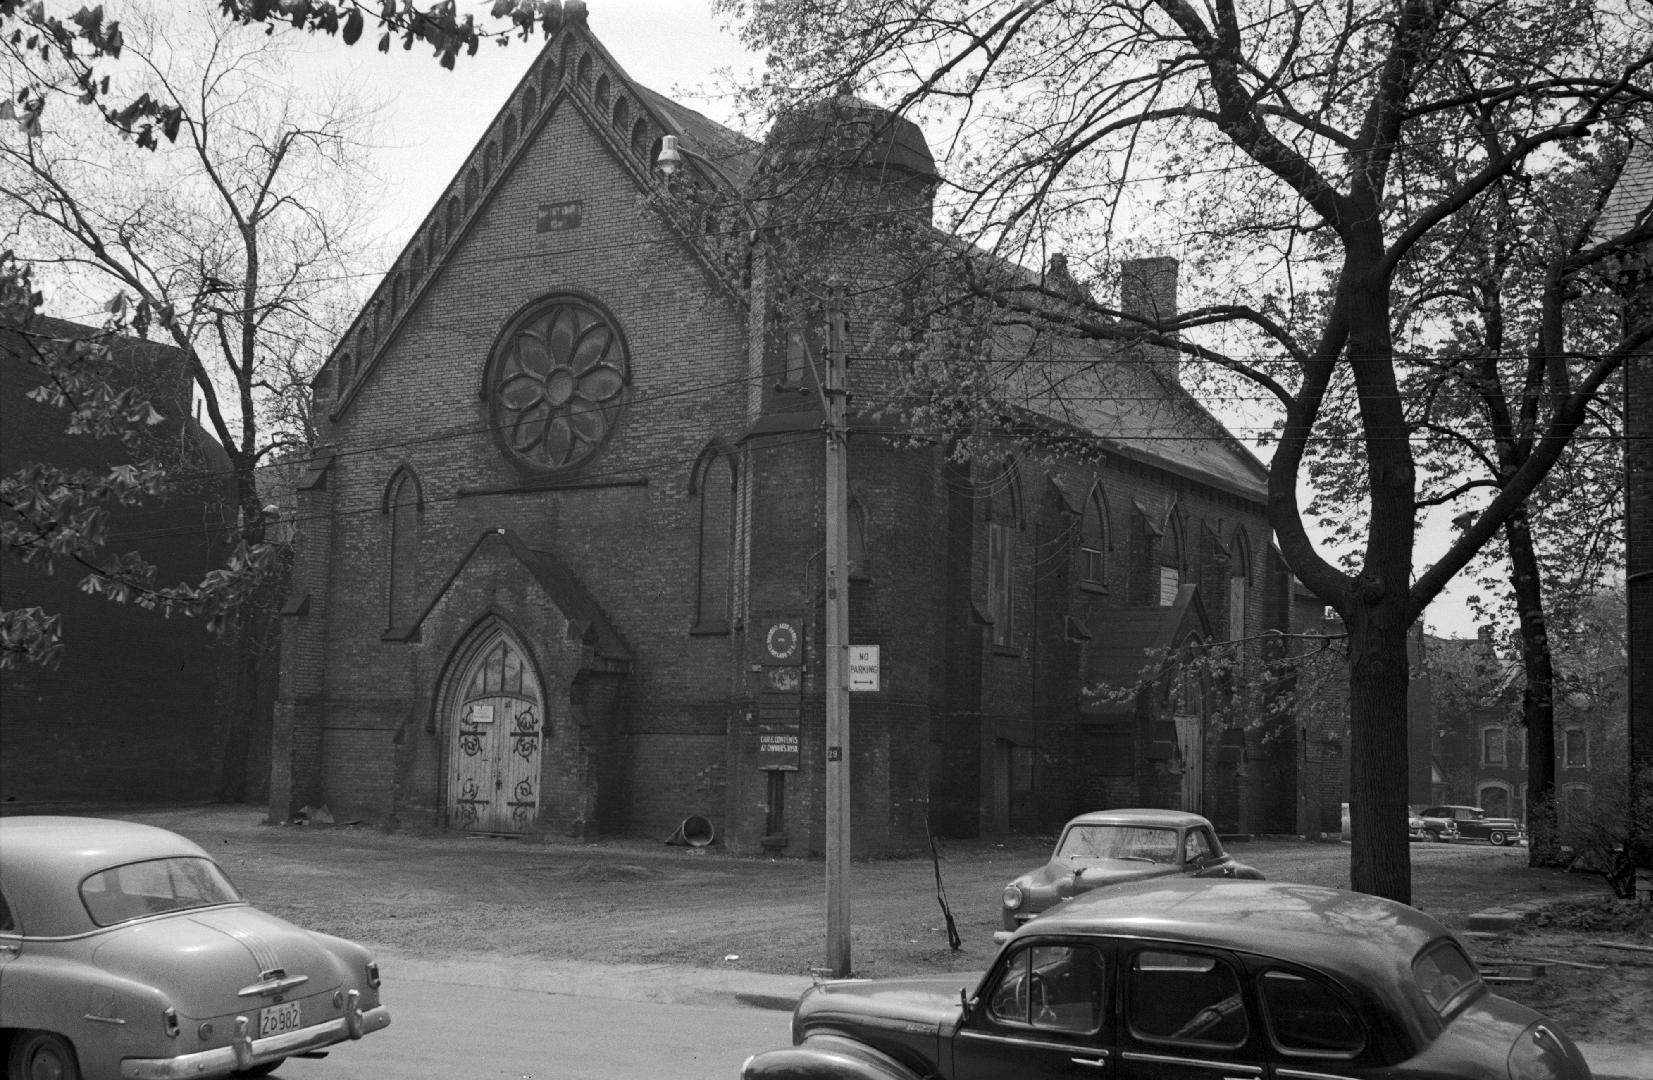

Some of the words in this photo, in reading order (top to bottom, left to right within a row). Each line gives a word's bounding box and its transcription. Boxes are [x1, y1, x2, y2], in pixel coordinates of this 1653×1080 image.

[859, 652, 869, 661] NO
[850, 664, 878, 674] PARKING
[760, 735, 771, 743] CAR
[774, 735, 798, 745] CONTENTS
[760, 744, 767, 752] AT
